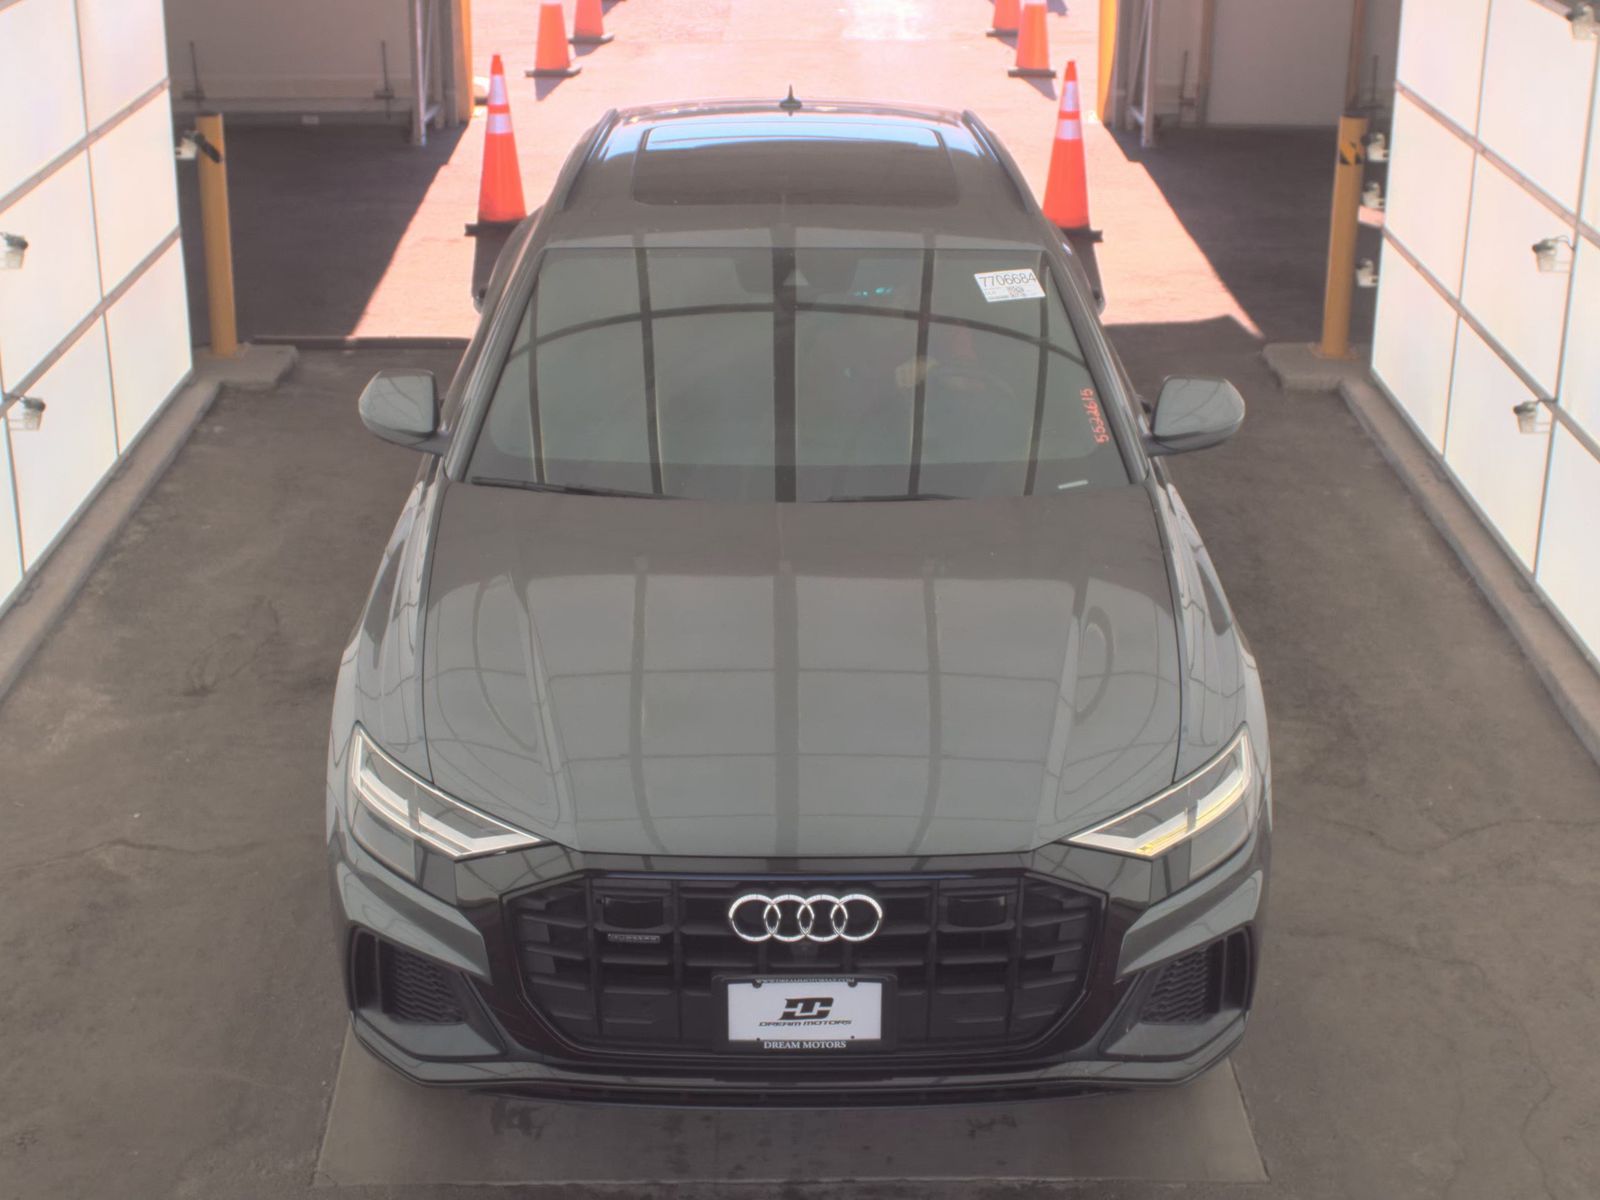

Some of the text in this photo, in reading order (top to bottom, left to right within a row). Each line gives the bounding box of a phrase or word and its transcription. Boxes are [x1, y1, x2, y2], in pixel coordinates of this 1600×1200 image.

[979, 271, 1036, 288] 7706684
[763, 1040, 847, 1049] DREAM MOTORS
